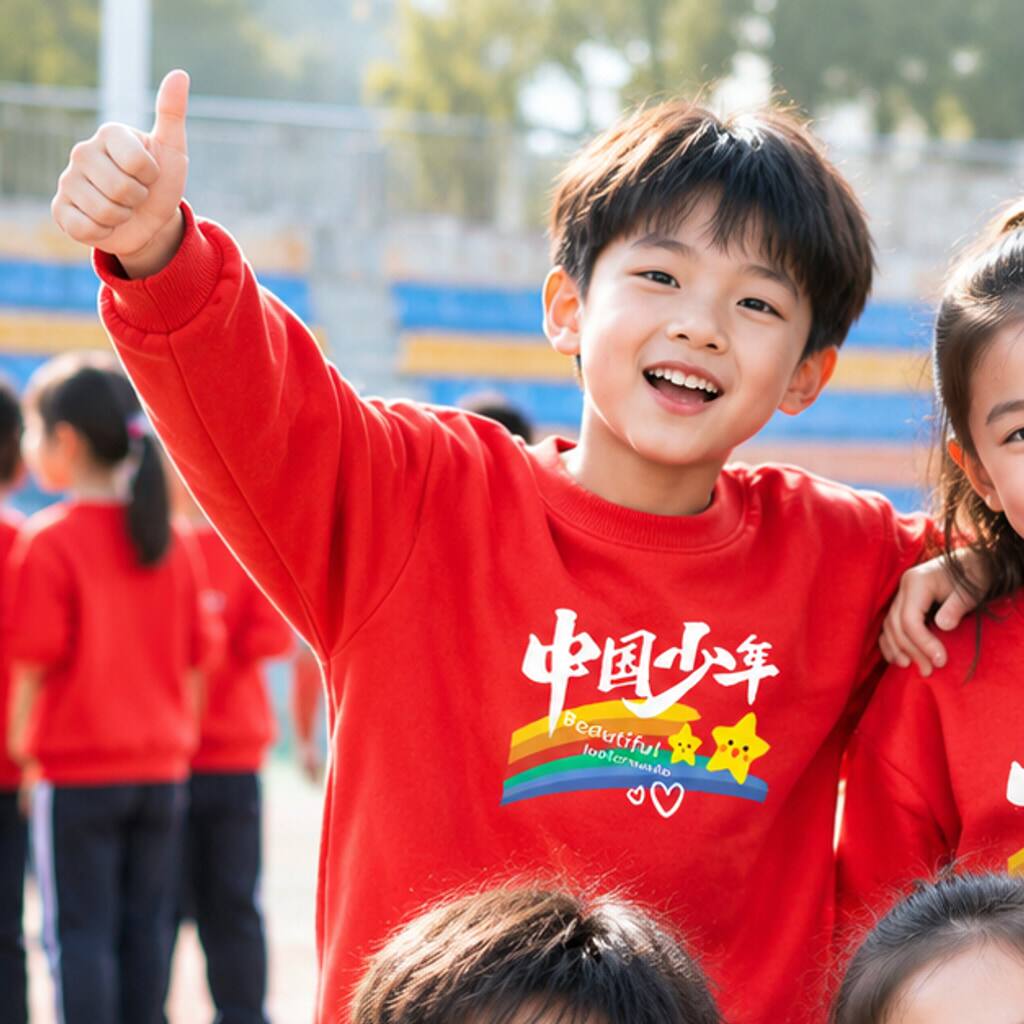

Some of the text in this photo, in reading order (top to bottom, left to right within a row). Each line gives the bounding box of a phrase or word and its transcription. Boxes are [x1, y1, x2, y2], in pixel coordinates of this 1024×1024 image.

[521, 608, 780, 738] 中国少年
[562, 711, 661, 758] Beautiful
